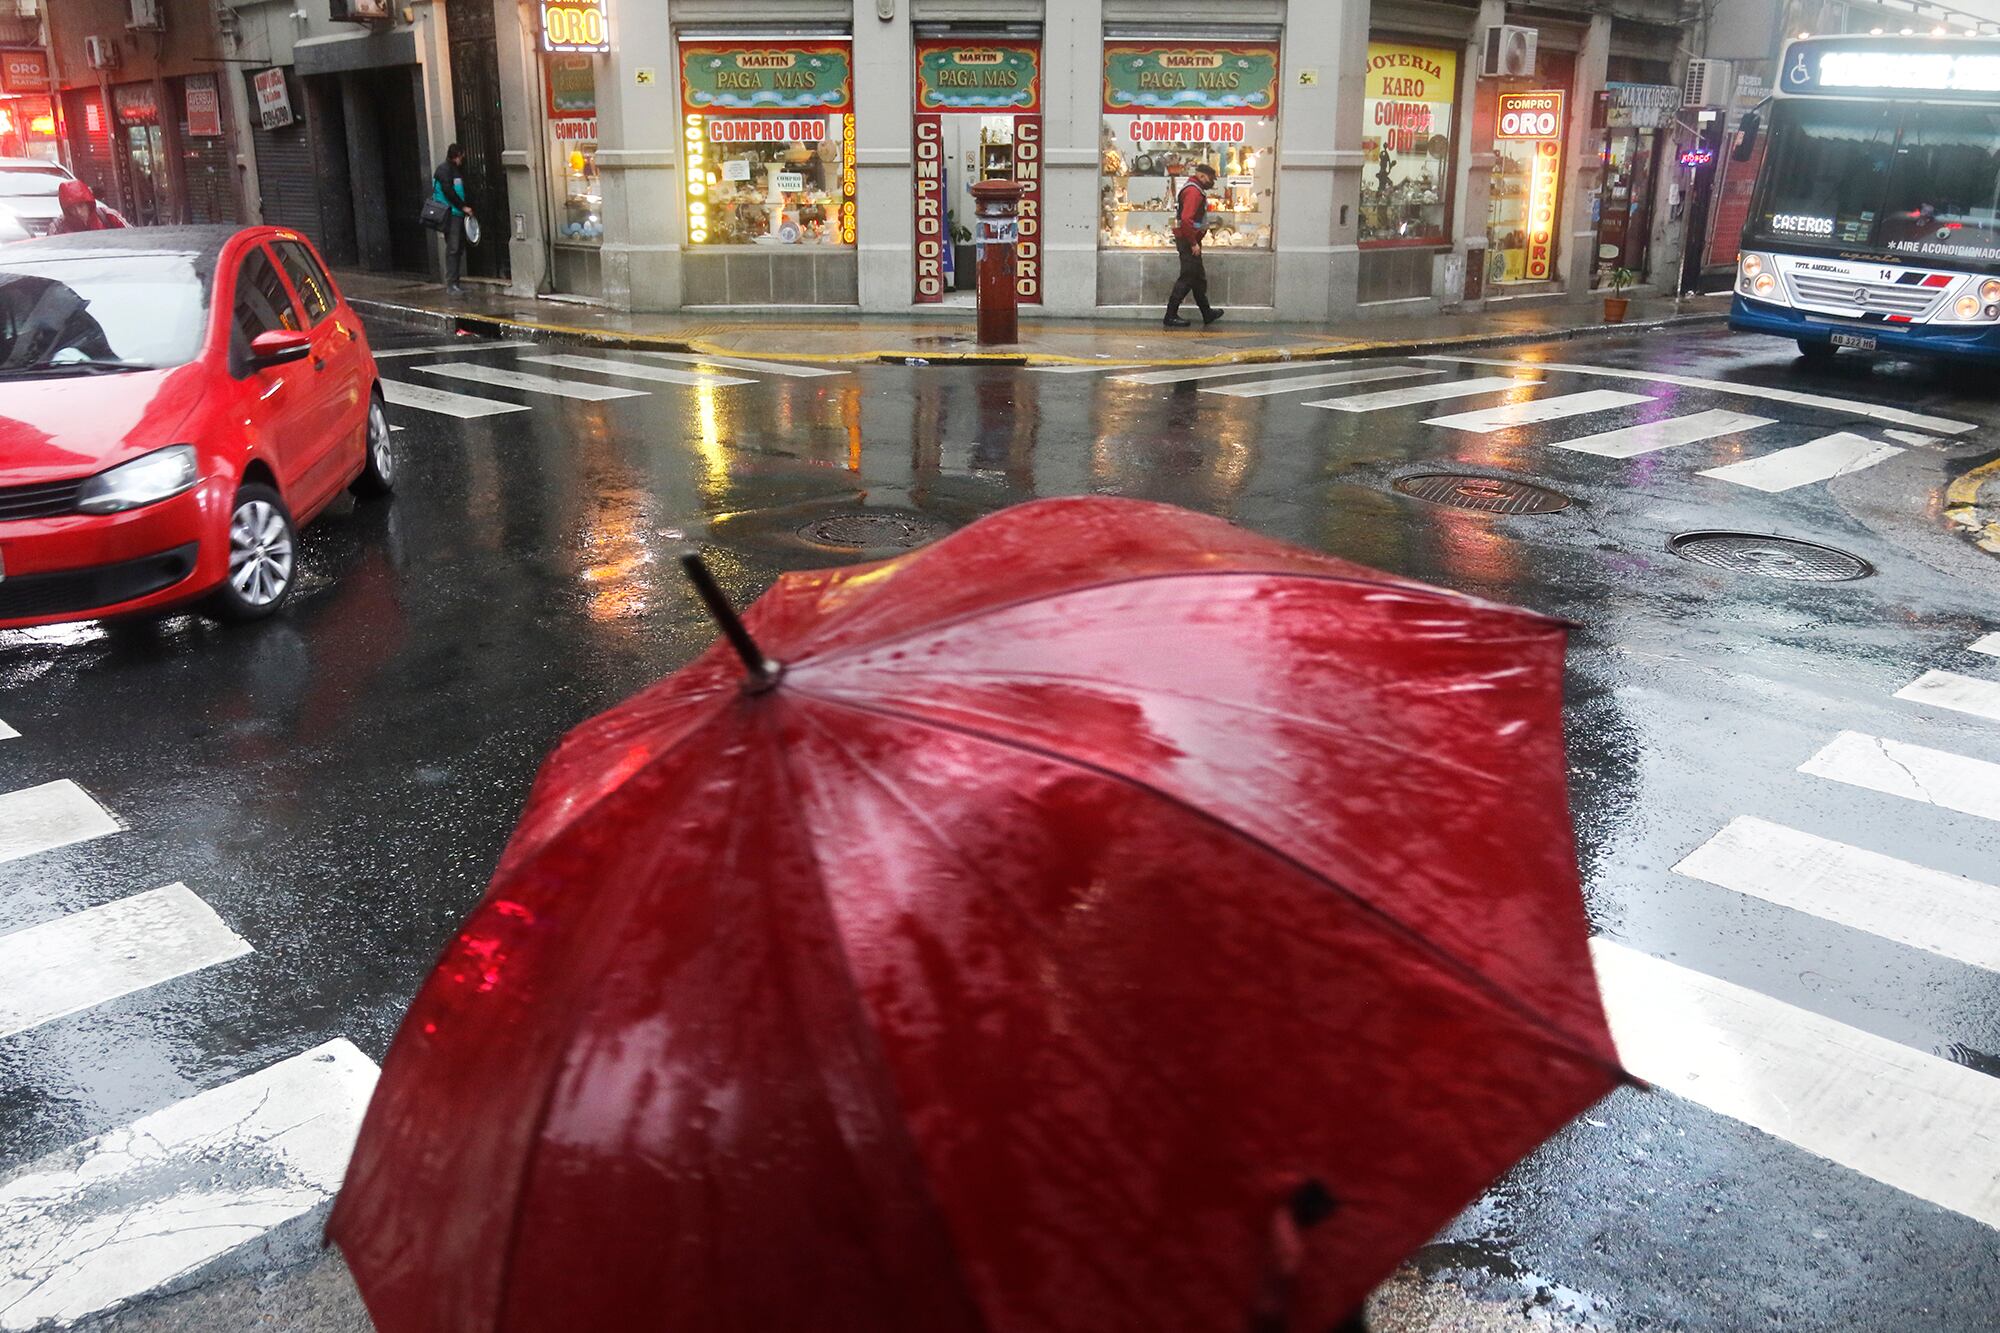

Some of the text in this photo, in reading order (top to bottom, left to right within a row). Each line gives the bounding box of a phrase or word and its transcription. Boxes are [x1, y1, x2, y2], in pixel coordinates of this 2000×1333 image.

[546, 6, 604, 45] ORO
[742, 55, 789, 67] MARTIN
[959, 53, 997, 62] MARTIN
[1167, 56, 1214, 67] MARTIN
[1365, 53, 1441, 80] JOYERIA
[10, 63, 40, 74] ORO
[938, 69, 1018, 88] PAGA MAS
[716, 71, 816, 90] PAGA MAS
[1138, 71, 1240, 91] PAGA MAS
[1382, 77, 1425, 98] KARO
[1506, 99, 1552, 109] COMPRO
[1620, 86, 1675, 108] MAXIKIOSCO
[555, 121, 598, 139] COMPRO O
[710, 120, 825, 141] COMPRO ORO
[1129, 120, 1245, 142] COMPRO ORO
[1501, 112, 1555, 135] ORO
[685, 113, 706, 197] COMPRO
[843, 113, 856, 197] COMPRO
[1681, 153, 1710, 164] KIOSCO
[917, 122, 939, 235] COMPRO
[1016, 123, 1038, 236] COMPRO
[1535, 141, 1557, 223] OMPRO
[843, 201, 856, 243] ORO
[1772, 214, 1833, 234] CASEROS
[1530, 230, 1549, 277] ORO
[1920, 242, 2000, 260] ACONDICIONADO
[918, 240, 940, 296] ORO
[1016, 241, 1038, 296] ORO
[1811, 264, 1837, 273] AMERICA
[1879, 269, 1892, 281] 14
[1845, 337, 1861, 347] 322
